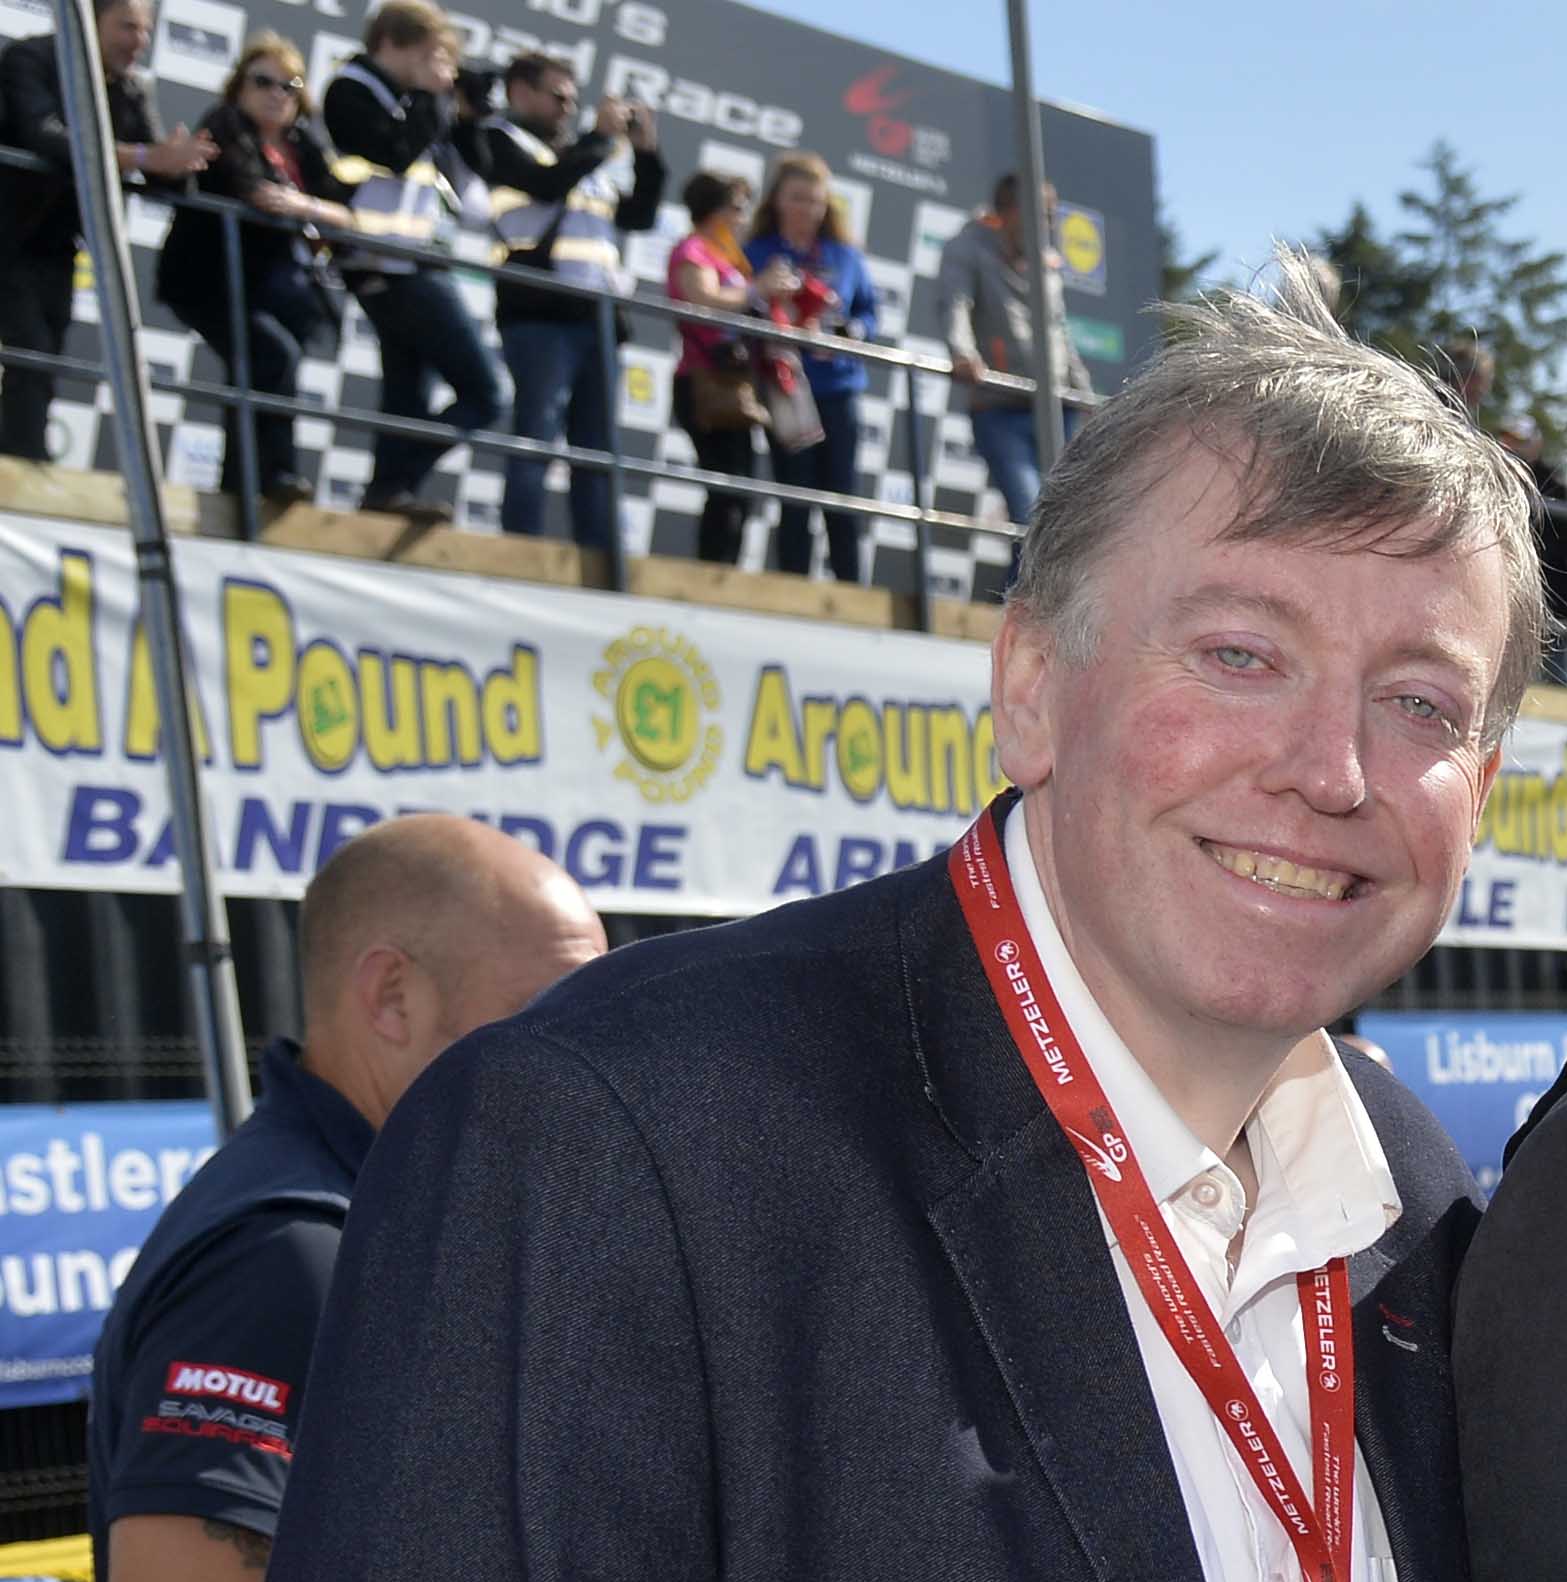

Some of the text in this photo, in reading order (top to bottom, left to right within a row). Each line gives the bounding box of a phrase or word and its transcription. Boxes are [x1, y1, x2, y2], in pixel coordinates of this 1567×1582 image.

[601, 53, 803, 147] Race
[222, 577, 543, 775] Pound
[1457, 876, 1515, 929] LE
[1007, 961, 1074, 1086] METZELER
[1427, 1029, 1558, 1084] Lisburn
[1100, 1130, 1128, 1164] GP
[173, 1367, 281, 1409] MOTUL
[1240, 1423, 1308, 1535] METZELER
